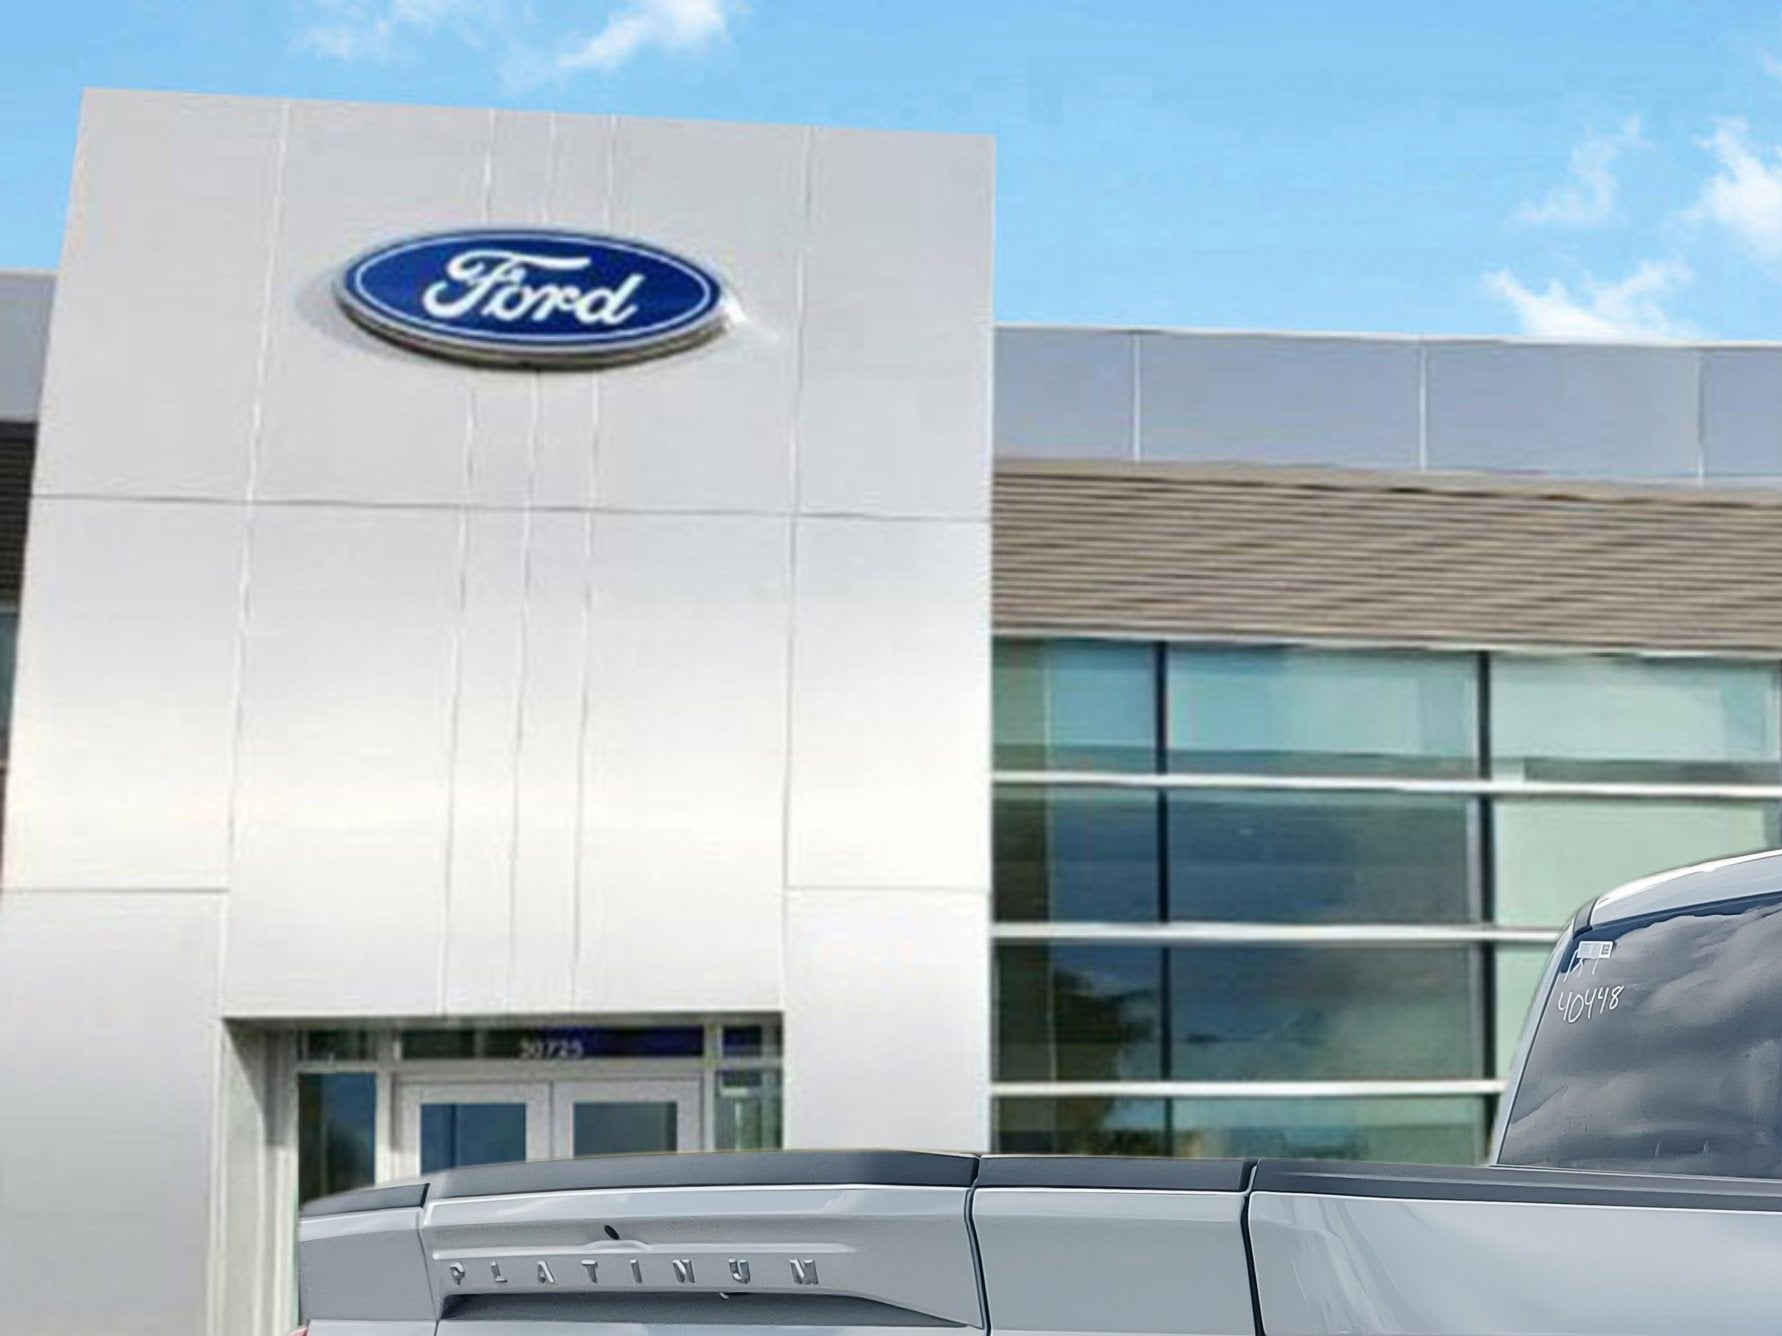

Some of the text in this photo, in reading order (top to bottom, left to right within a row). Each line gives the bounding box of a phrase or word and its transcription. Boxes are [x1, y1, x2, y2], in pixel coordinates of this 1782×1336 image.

[423, 249, 644, 326] Ford
[1557, 985, 1625, 1023] 40448
[449, 1257, 820, 1286] PLATINUM
